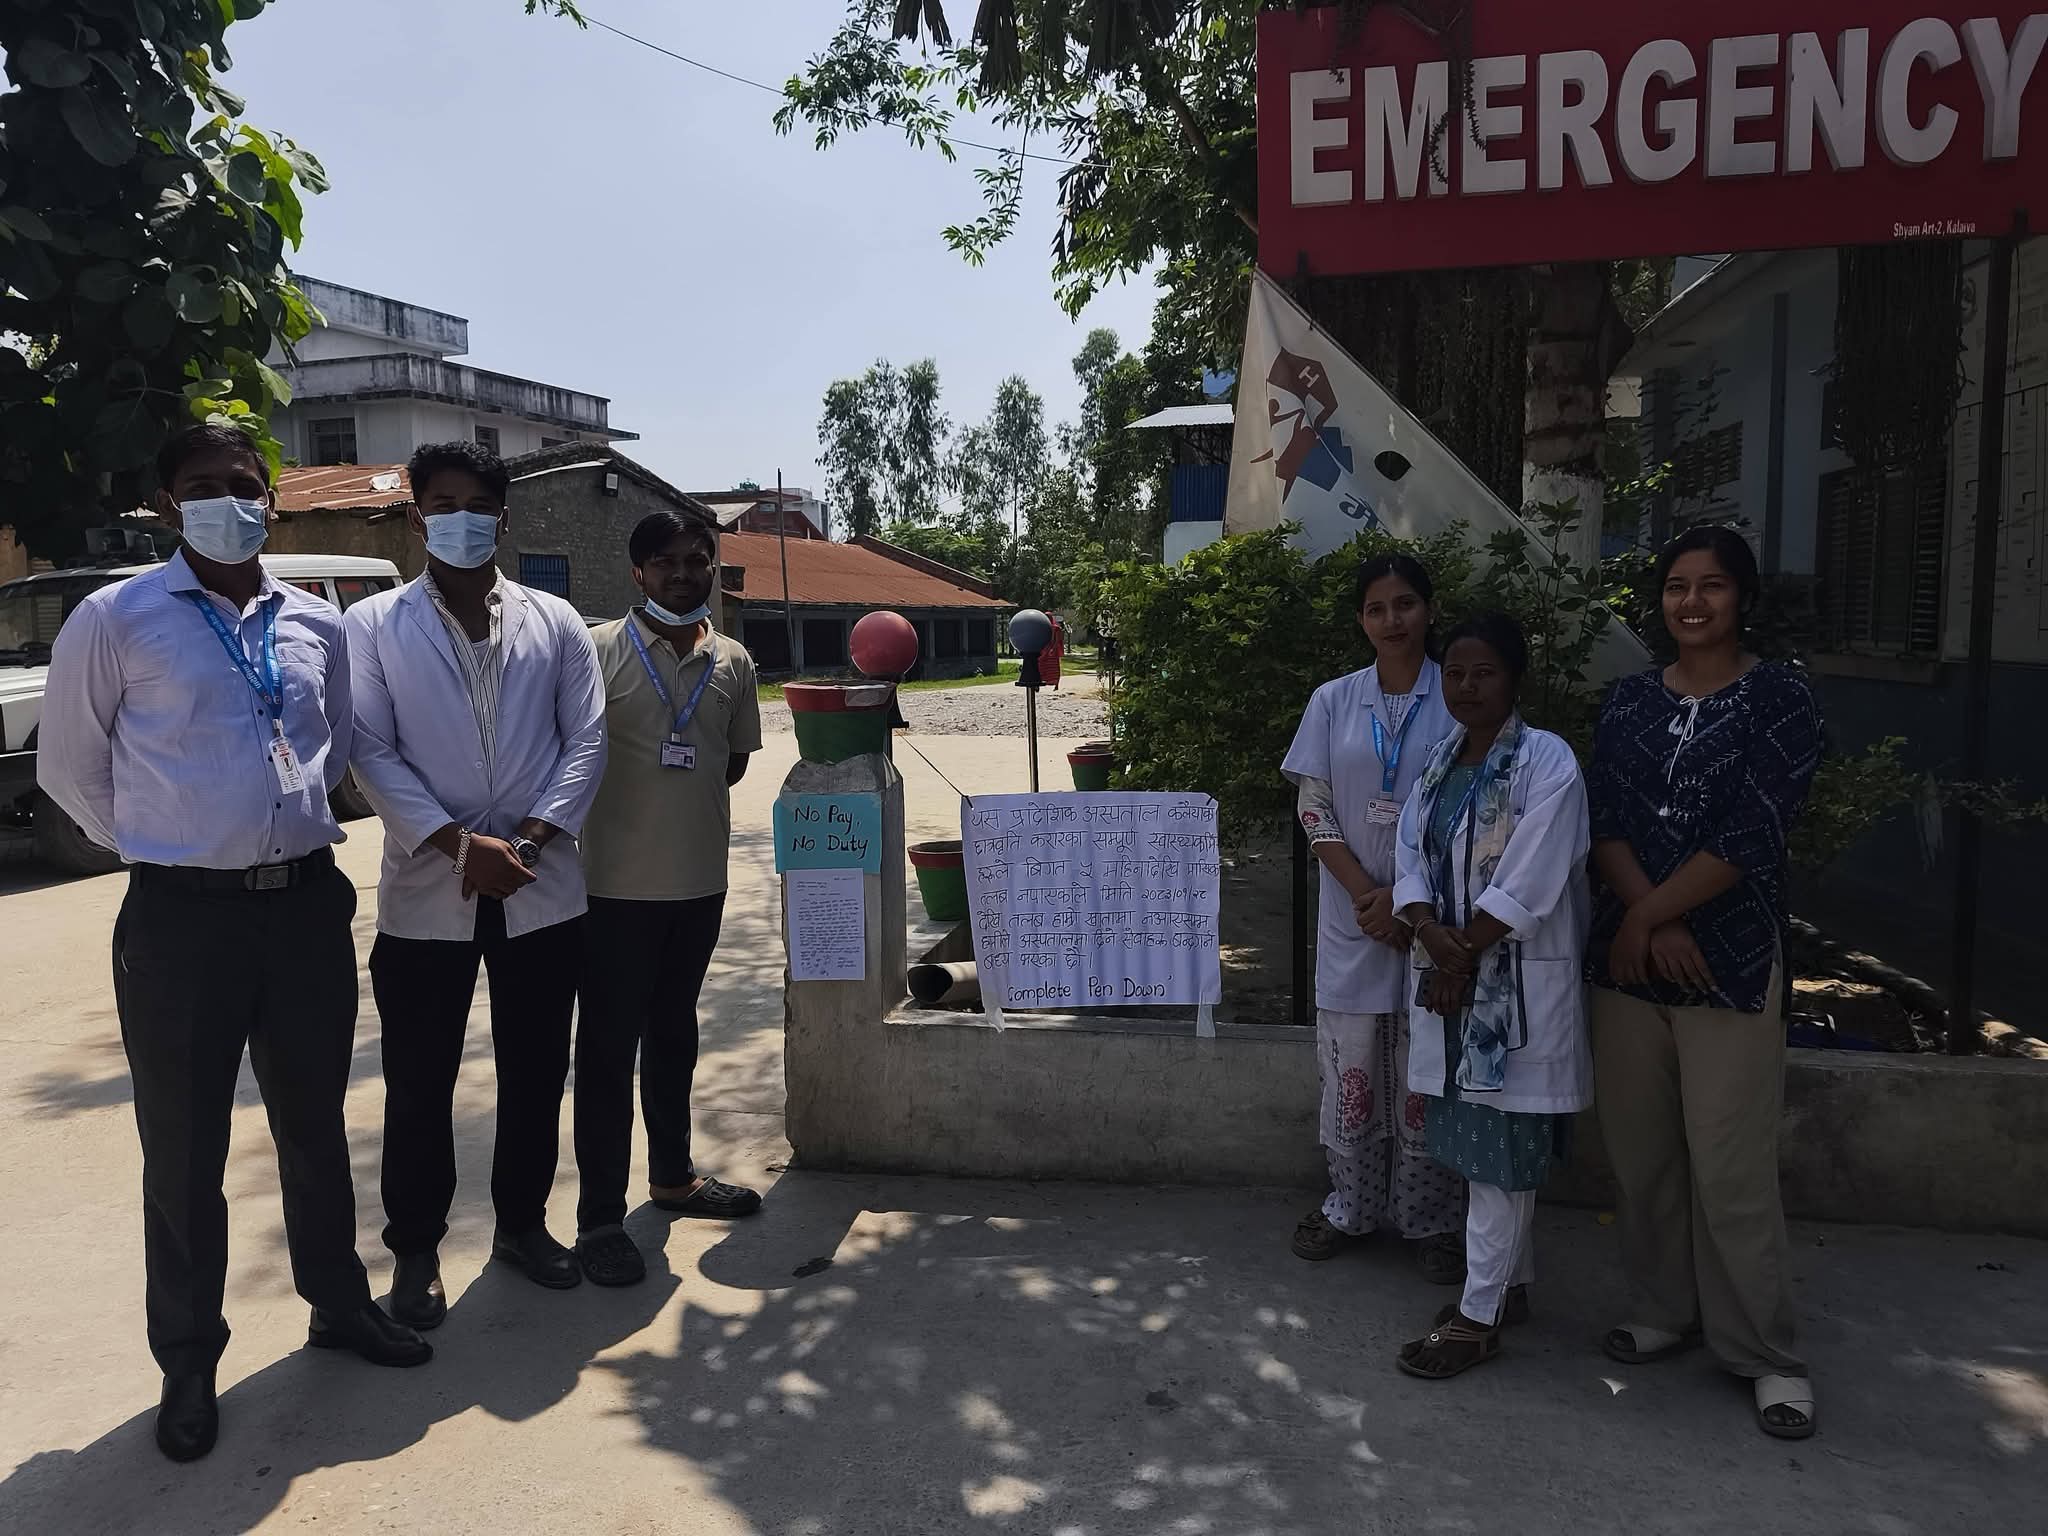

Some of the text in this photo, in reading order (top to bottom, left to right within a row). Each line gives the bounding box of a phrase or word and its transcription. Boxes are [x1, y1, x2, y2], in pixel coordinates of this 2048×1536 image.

[1290, 13, 2048, 208] EMERGENCY
[1894, 222, 1920, 240] Shyam
[794, 805, 820, 823] No
[1082, 804, 1162, 824] अस्पताल
[792, 834, 869, 860] No Duty
[1088, 975, 1113, 998] Pen
